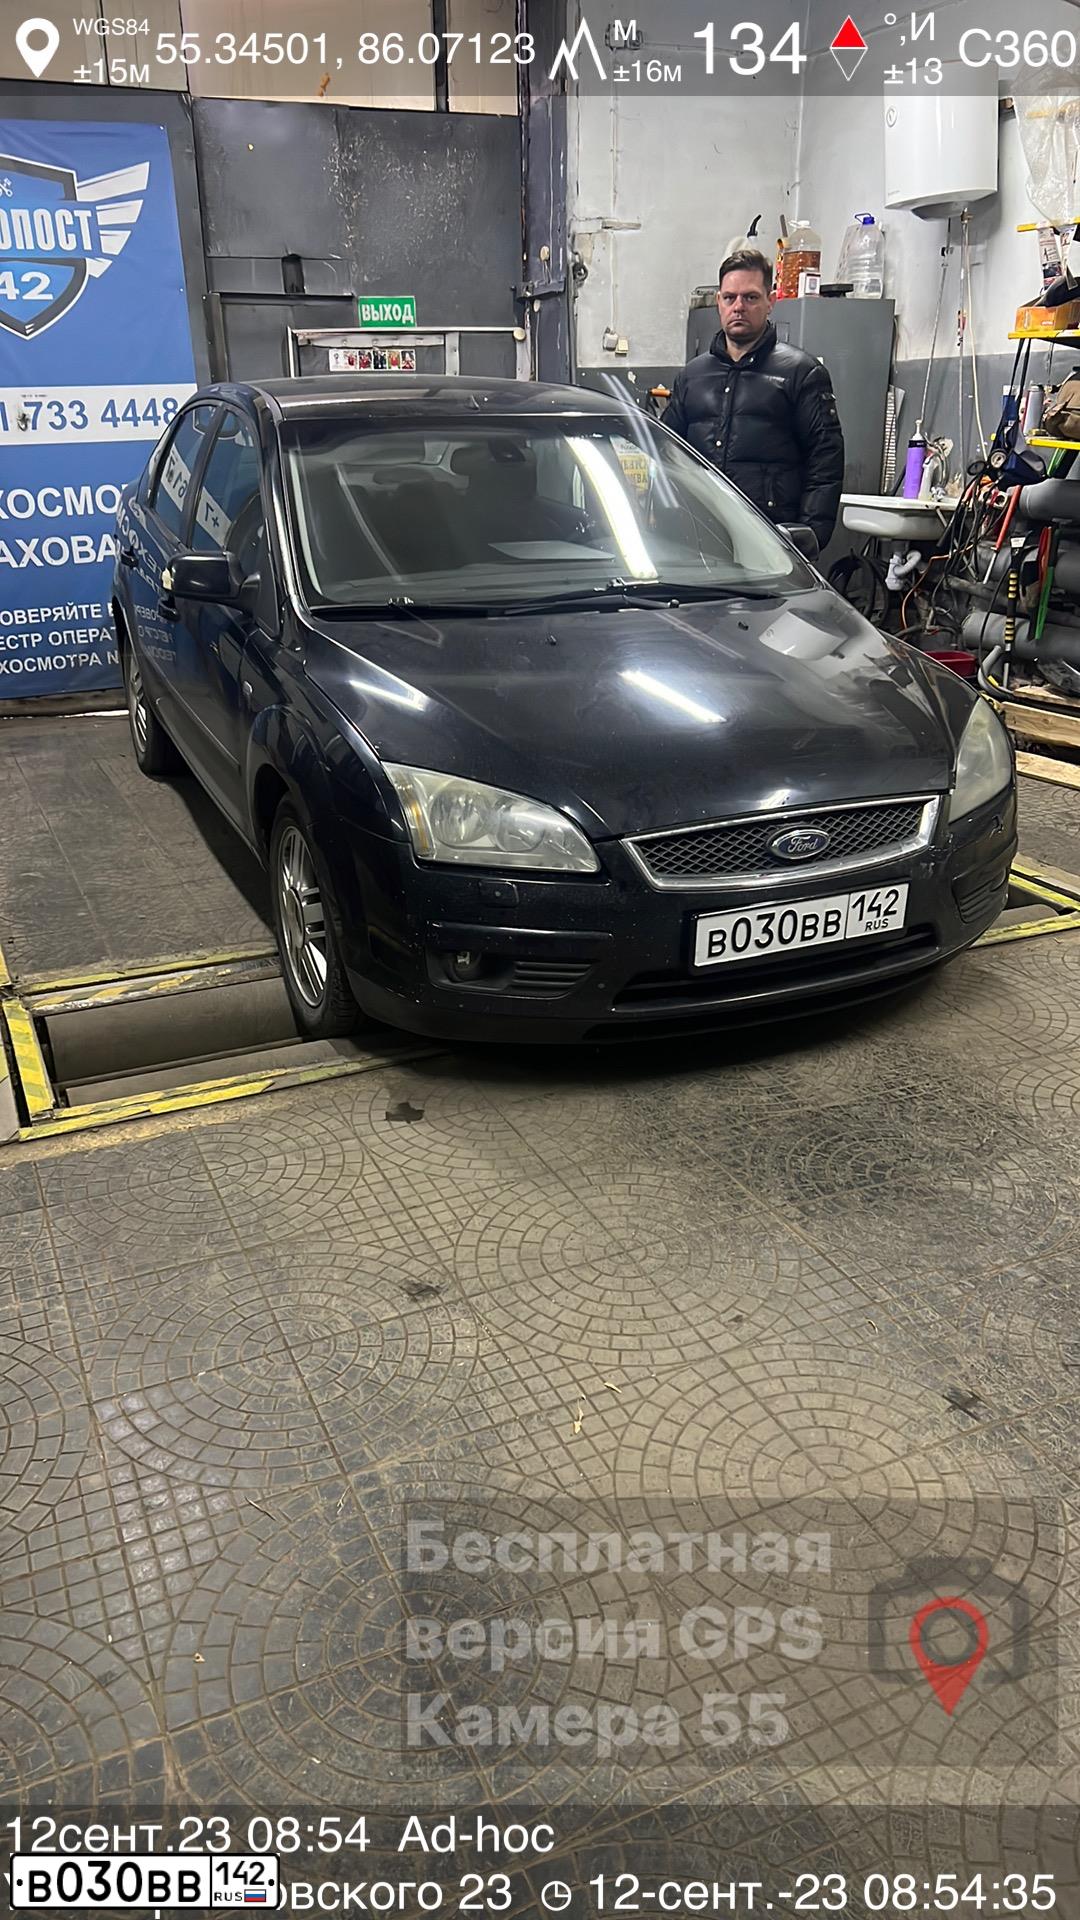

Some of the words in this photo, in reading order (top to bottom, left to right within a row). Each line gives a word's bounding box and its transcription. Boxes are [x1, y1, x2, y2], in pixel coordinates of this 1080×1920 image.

[361, 303, 415, 325] ВЫХОД
[23, 400, 89, 431] 733
[100, 397, 179, 428] 4448
[48, 626, 116, 646] ОПЕРА
[788, 836, 818, 853] Ford
[852, 887, 899, 923] 142
[864, 921, 890, 933] RUS
